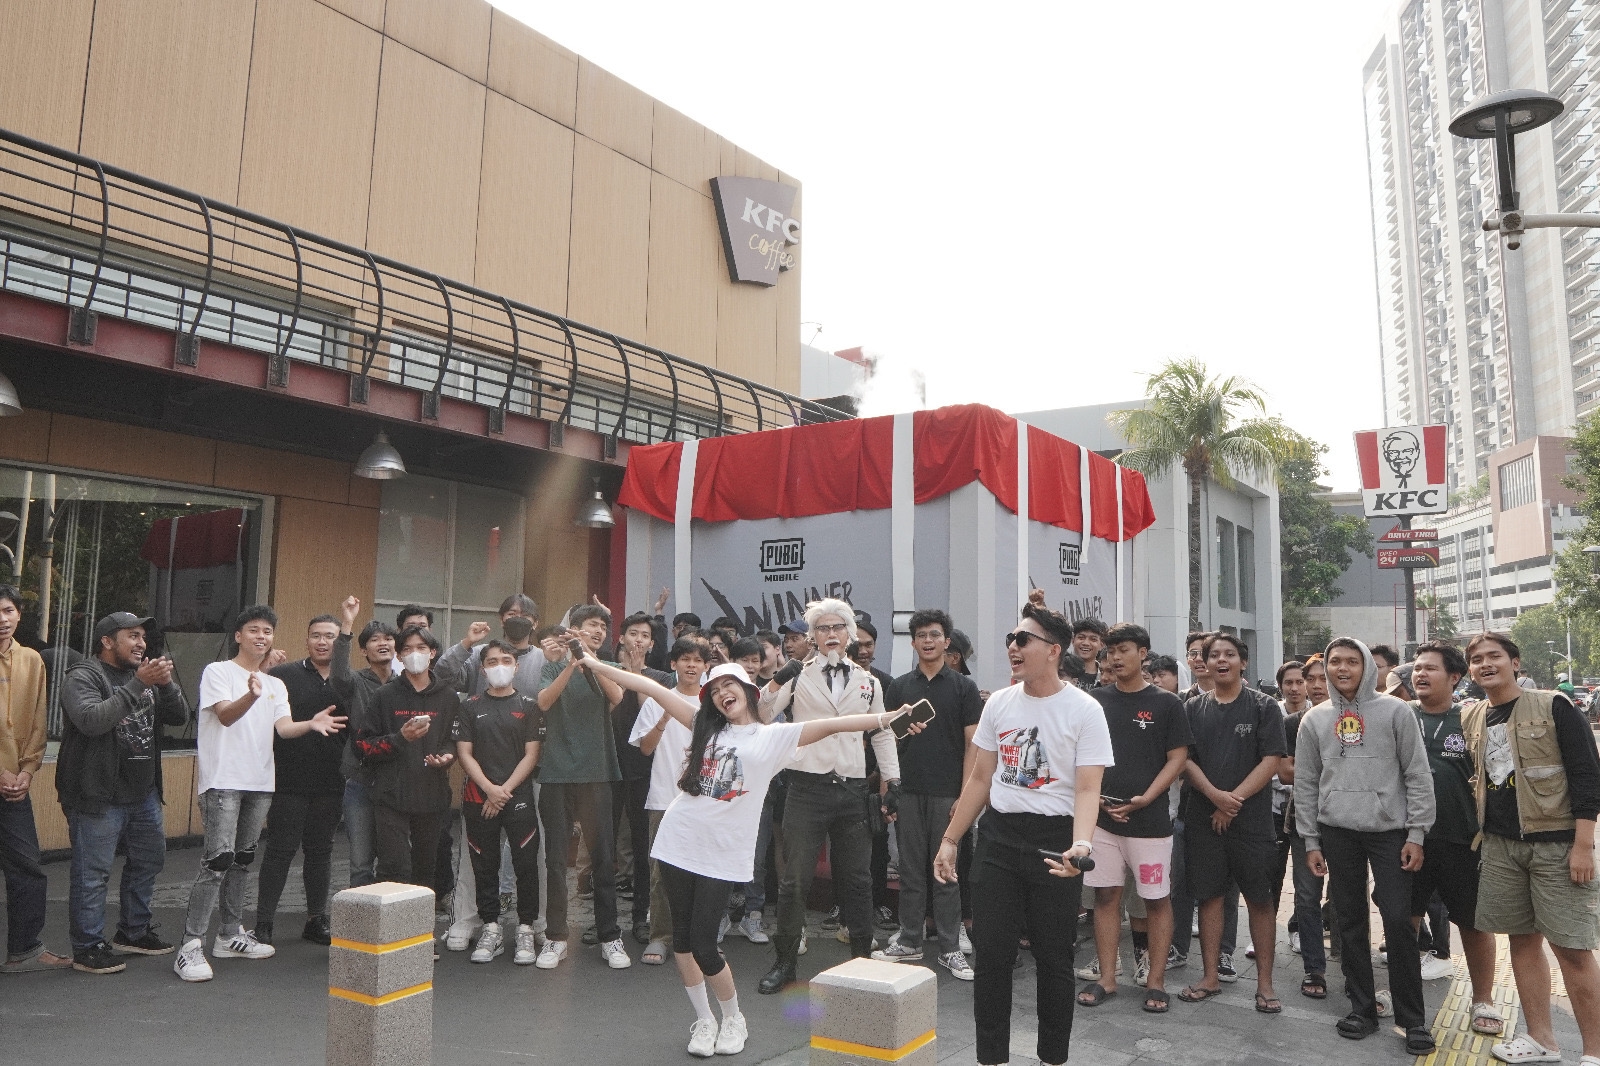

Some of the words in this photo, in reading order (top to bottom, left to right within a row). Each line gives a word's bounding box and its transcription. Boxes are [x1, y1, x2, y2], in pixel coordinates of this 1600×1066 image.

[741, 197, 800, 244] KFC
[1372, 489, 1439, 512] KFC
[1387, 532, 1411, 540] DRIVE
[1414, 531, 1437, 539] THRU
[766, 543, 799, 567] PUBG
[1062, 548, 1078, 571] PUBG
[1379, 550, 1398, 558] OPEN
[1379, 556, 1396, 566] 24
[1399, 555, 1426, 563] HOURS
[764, 573, 800, 583] MOBILE
[1062, 577, 1079, 586] MOBILE
